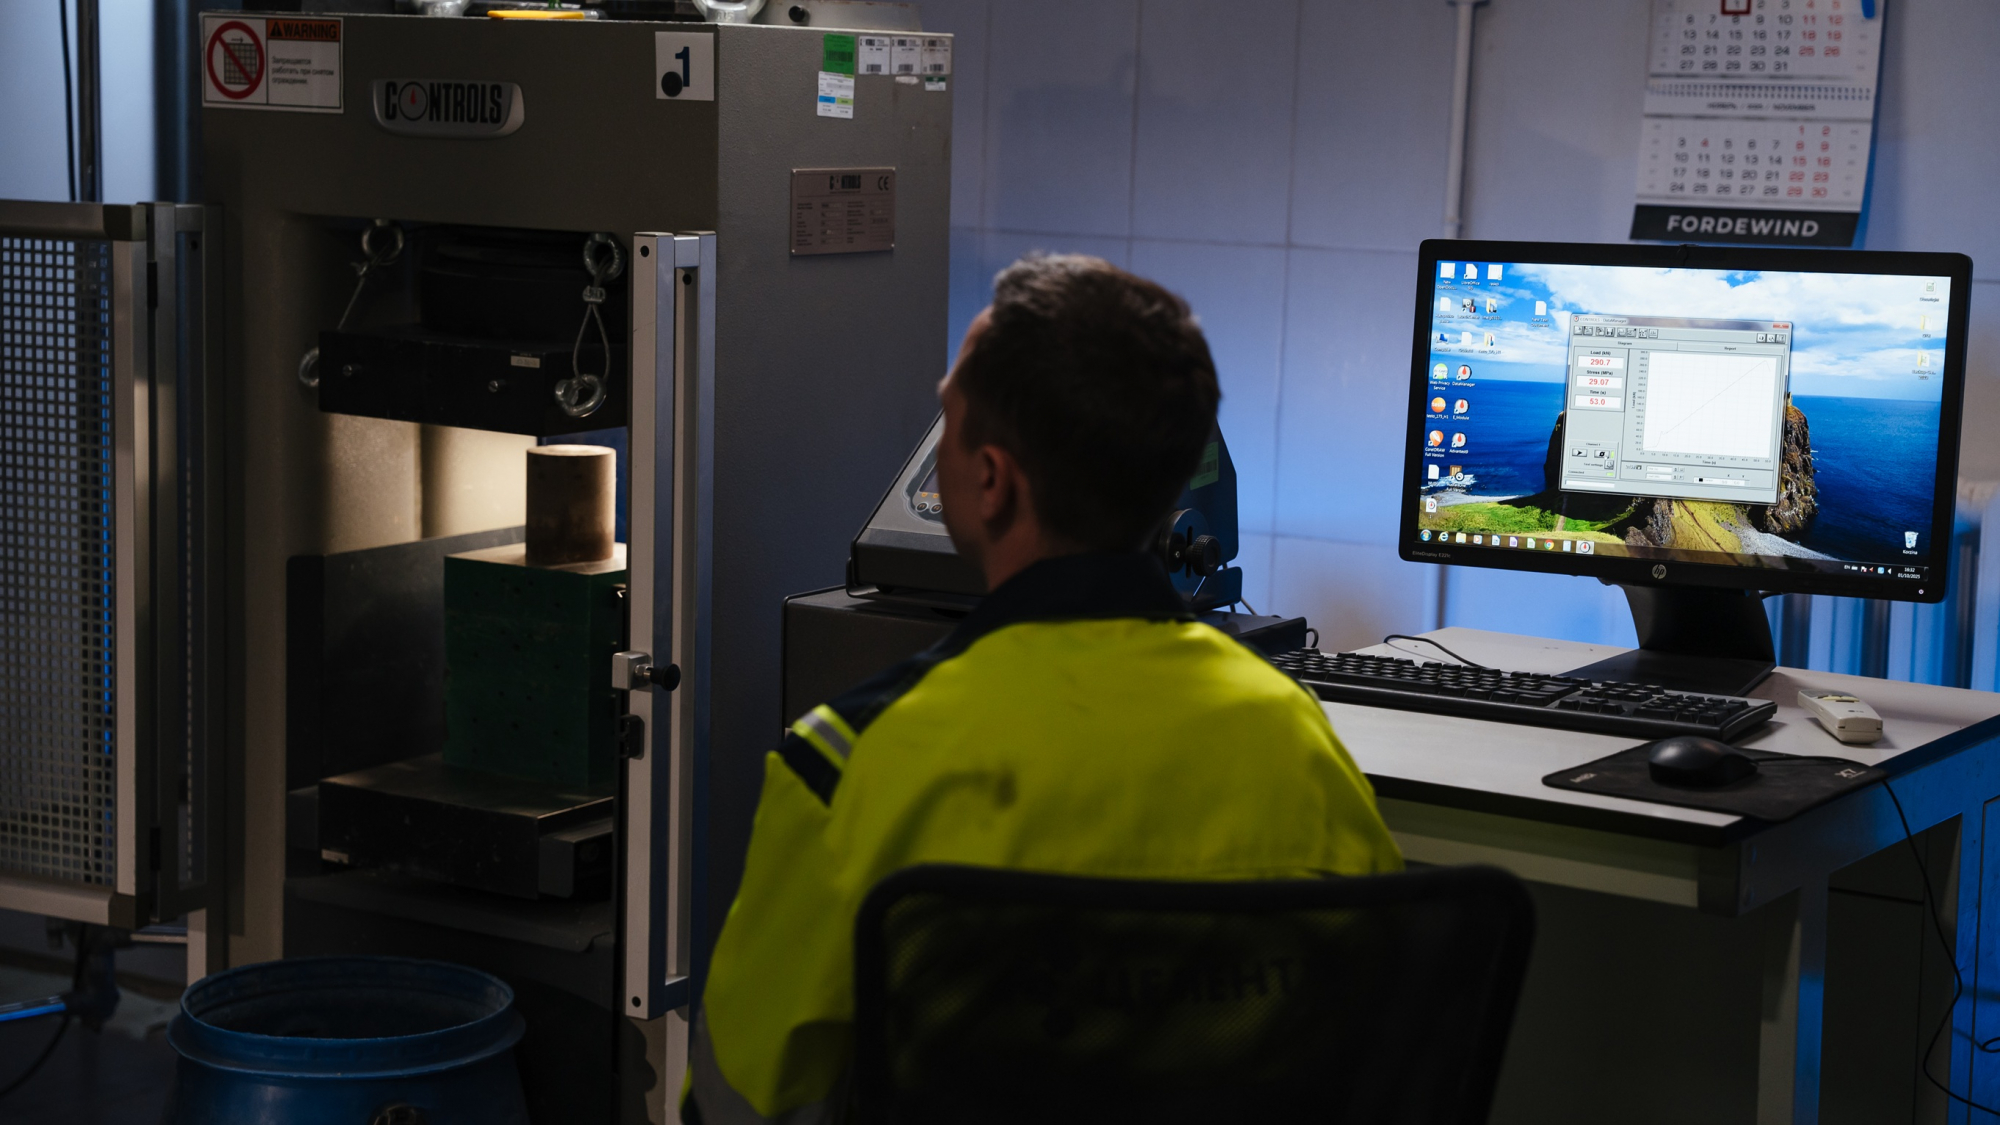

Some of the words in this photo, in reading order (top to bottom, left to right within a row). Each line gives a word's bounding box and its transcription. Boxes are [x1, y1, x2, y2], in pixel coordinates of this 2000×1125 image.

[1686, 14, 1694, 24] 6
[1708, 14, 1717, 24] 7
[1731, 14, 1741, 24] 8
[1756, 15, 1764, 25] 9
[1779, 15, 1793, 25] 10
[1803, 15, 1816, 24] 11
[1828, 15, 1843, 25] 12
[283, 22, 337, 39] WARNING
[1684, 30, 1696, 40] 13
[1706, 30, 1719, 40] 14
[1729, 30, 1742, 40] 15
[1754, 30, 1766, 40] 16
[1777, 30, 1791, 40] 17
[1802, 31, 1816, 41] 18
[1827, 31, 1842, 41] 19
[1681, 45, 1696, 55] 20
[1704, 45, 1717, 55] 21
[1727, 45, 1741, 55] 22
[1751, 46, 1766, 56] 23
[1775, 46, 1789, 56] 24
[1799, 46, 1815, 56] 25
[1824, 46, 1839, 56] 26
[675, 46, 690, 87] 1
[1680, 60, 1694, 70] 27
[1703, 61, 1717, 70] 28
[1726, 61, 1741, 71] 29
[1751, 61, 1765, 70] 30
[1774, 61, 1787, 72] 31
[385, 81, 502, 124] CONTROLS
[1799, 125, 1804, 135] 1
[1822, 126, 1830, 136] 2
[1675, 152, 1689, 163] 10
[1698, 153, 1710, 163] 11
[1721, 154, 1734, 164] 12
[1745, 155, 1758, 165] 13
[1769, 156, 1782, 165] 14
[1793, 156, 1806, 166] 15
[1818, 157, 1830, 167] 16
[1673, 167, 1687, 177] 17
[1697, 169, 1710, 178] 18
[1720, 169, 1733, 179] 19
[1742, 170, 1757, 180] 20
[1765, 171, 1779, 181] 21
[1789, 171, 1805, 182] 22
[1813, 172, 1829, 182] 23
[1670, 182, 1685, 192] 24
[1693, 184, 1707, 193] 25
[1717, 184, 1731, 194] 26
[1740, 185, 1754, 195] 27
[1764, 186, 1778, 195] 28
[1787, 187, 1803, 197] 29
[1812, 187, 1827, 198] 30
[1667, 214, 1819, 237] FORDEWIND
[1588, 378, 1610, 386] 29.07
[1589, 398, 1606, 406] 53.0
